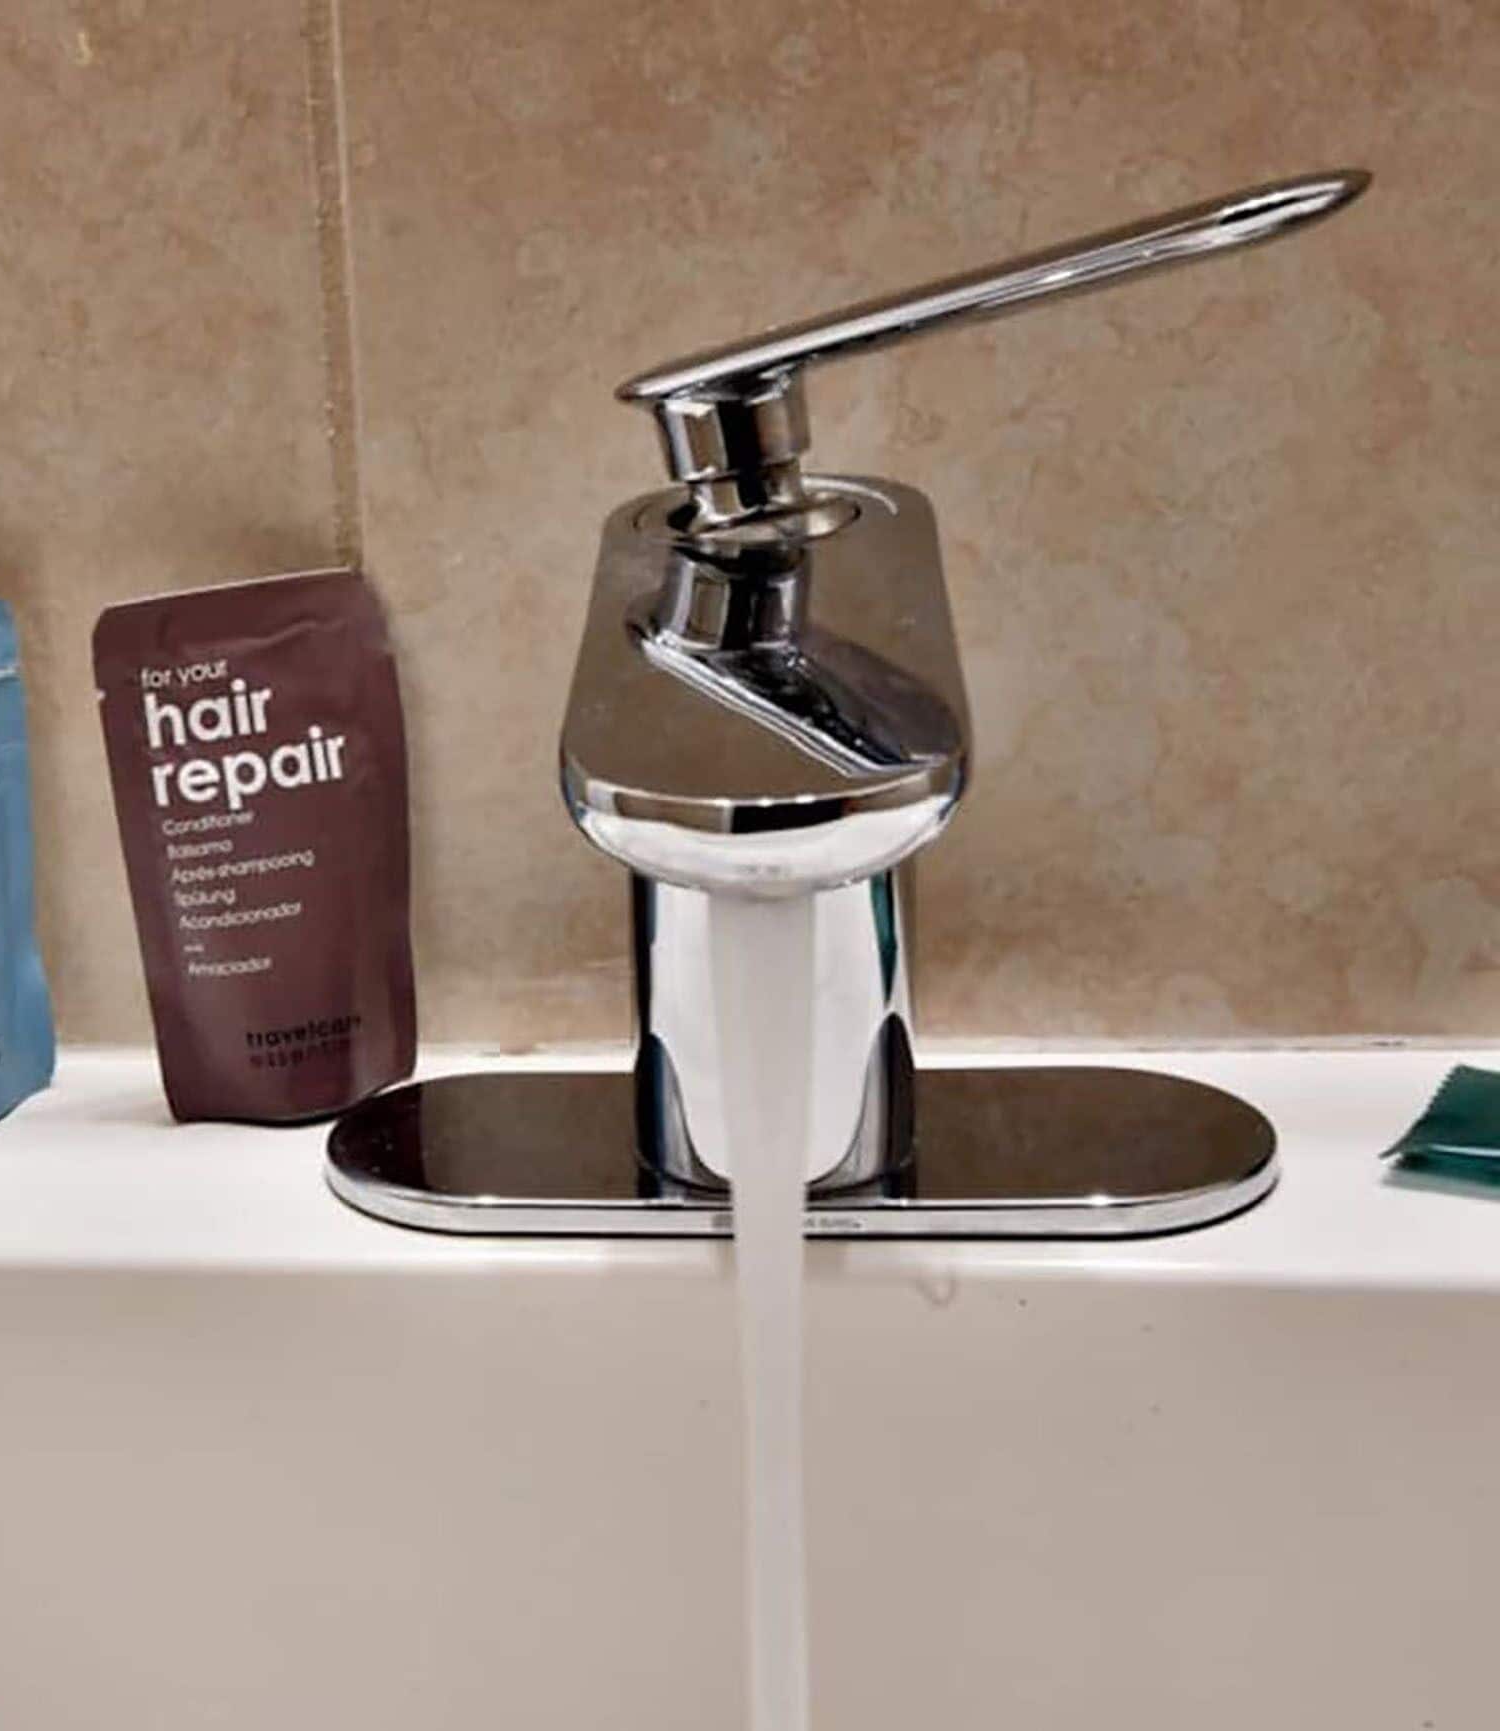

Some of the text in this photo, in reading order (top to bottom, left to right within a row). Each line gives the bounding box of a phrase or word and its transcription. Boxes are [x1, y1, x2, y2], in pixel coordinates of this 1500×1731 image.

[142, 660, 228, 688] for your
[144, 678, 272, 748] hair
[151, 725, 346, 811] repair
[161, 811, 254, 836] Conditioner
